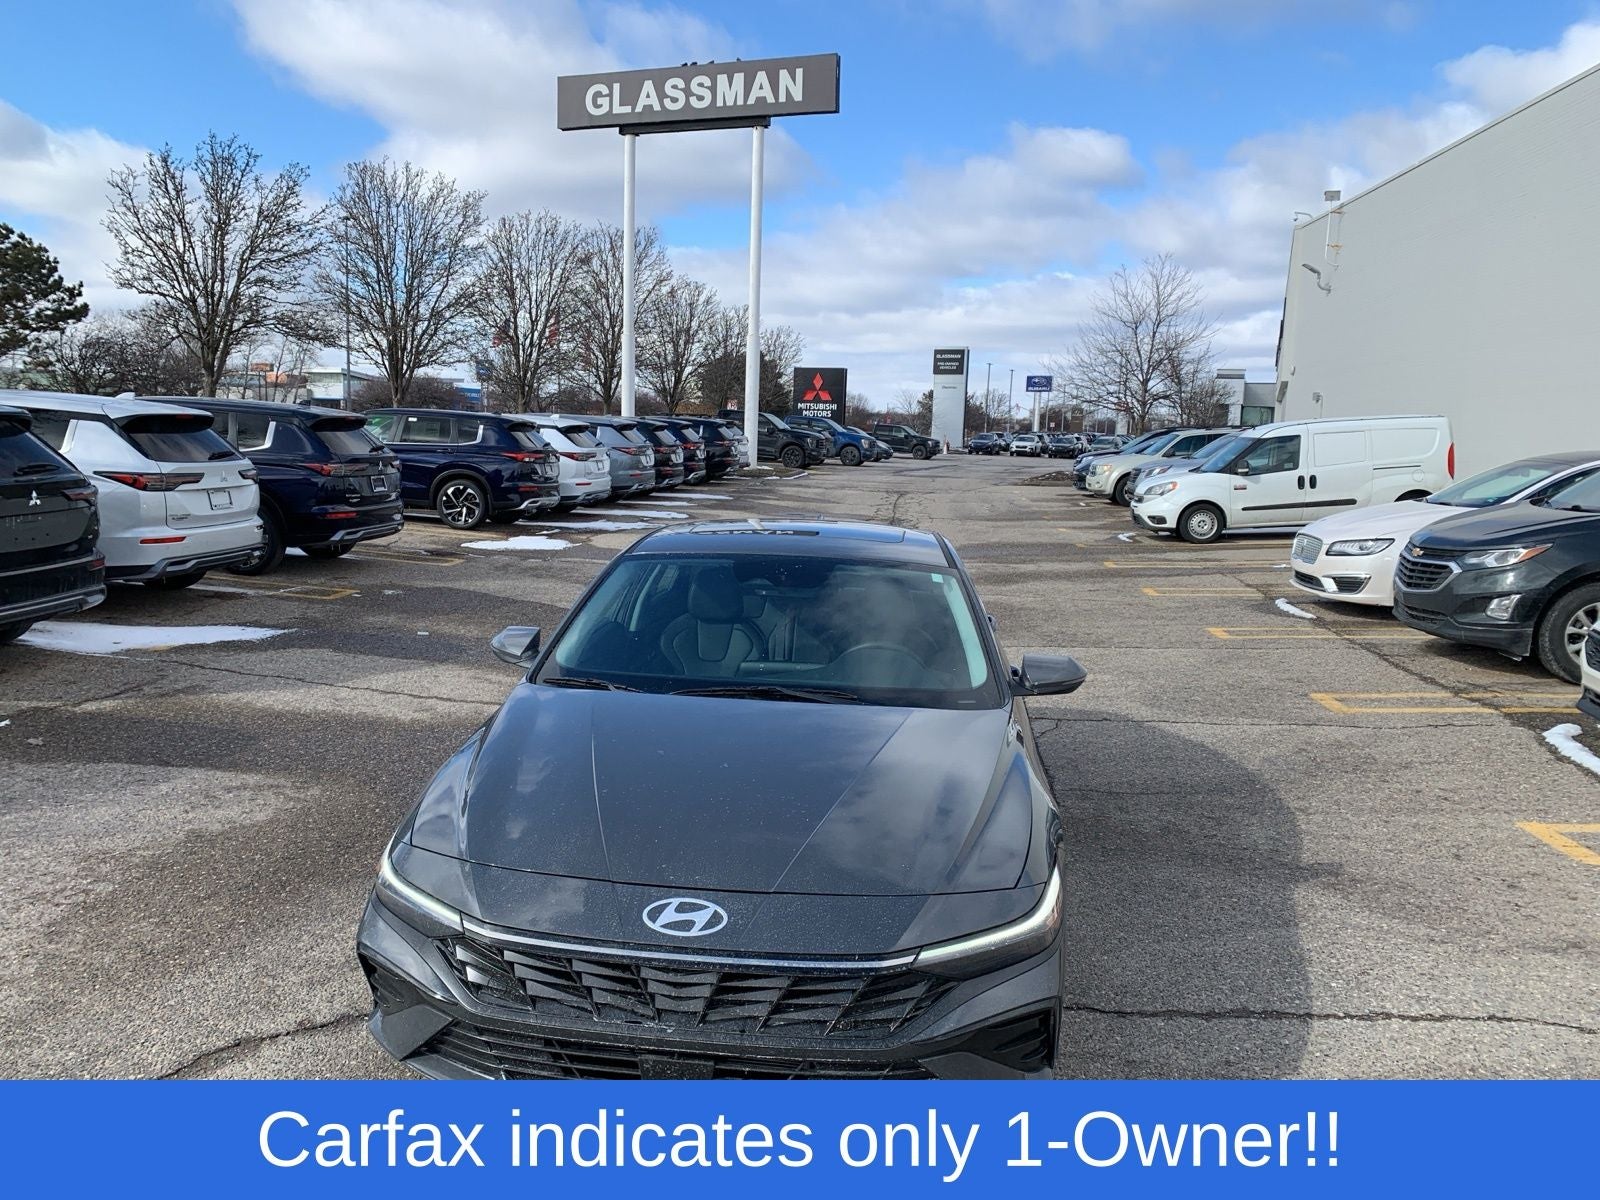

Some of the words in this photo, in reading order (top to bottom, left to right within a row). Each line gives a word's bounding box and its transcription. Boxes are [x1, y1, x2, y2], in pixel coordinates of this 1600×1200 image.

[585, 67, 804, 116] GLASSMAN
[797, 402, 837, 411] MITSUBISHI
[802, 410, 832, 418] MOTORS
